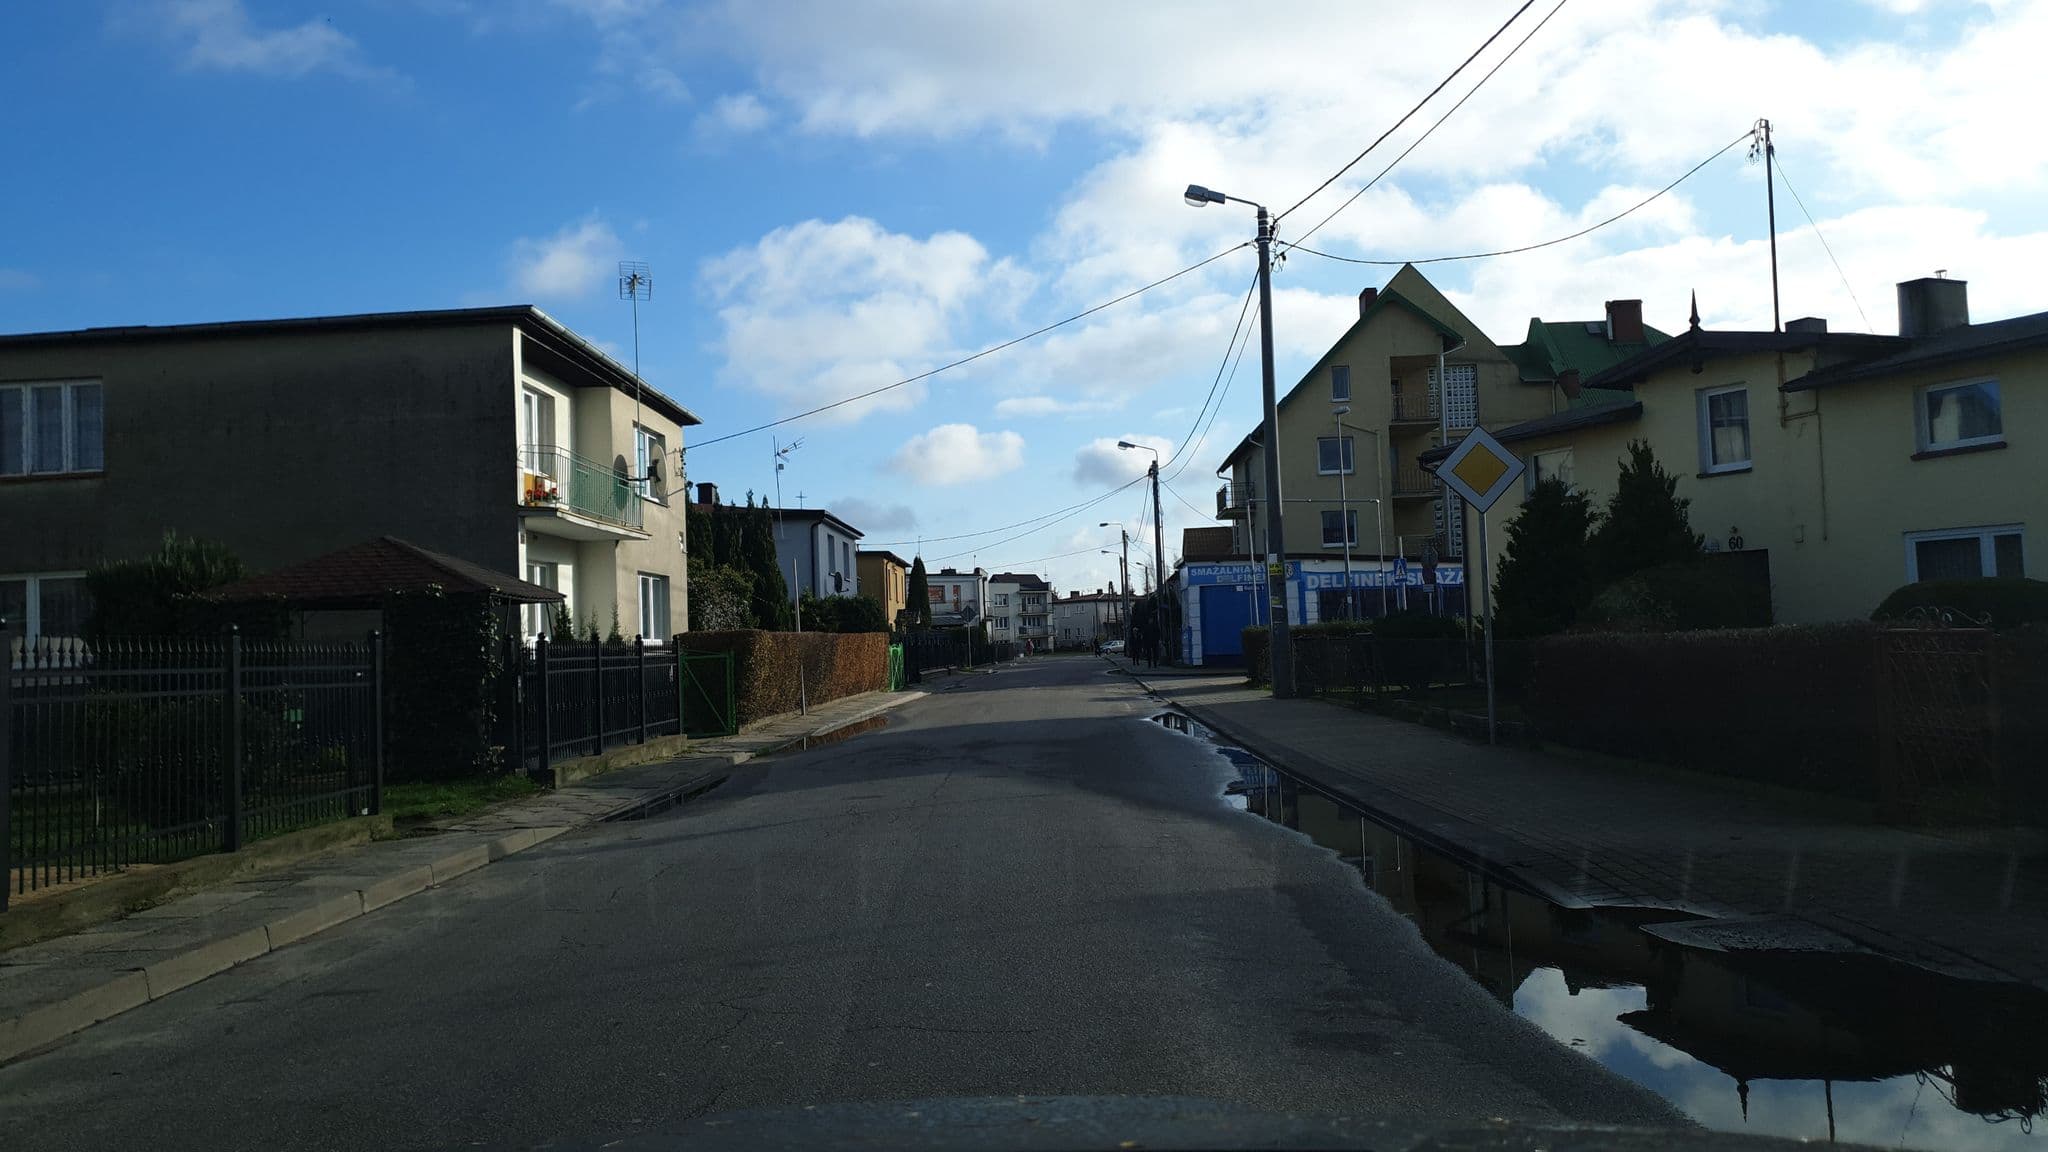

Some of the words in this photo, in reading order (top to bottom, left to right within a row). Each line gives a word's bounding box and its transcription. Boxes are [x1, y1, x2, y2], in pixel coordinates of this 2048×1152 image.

[1728, 536, 1743, 549] 60
[1191, 565, 1250, 576] SMAŻALNIA
[1217, 573, 1265, 583] DLFINE
